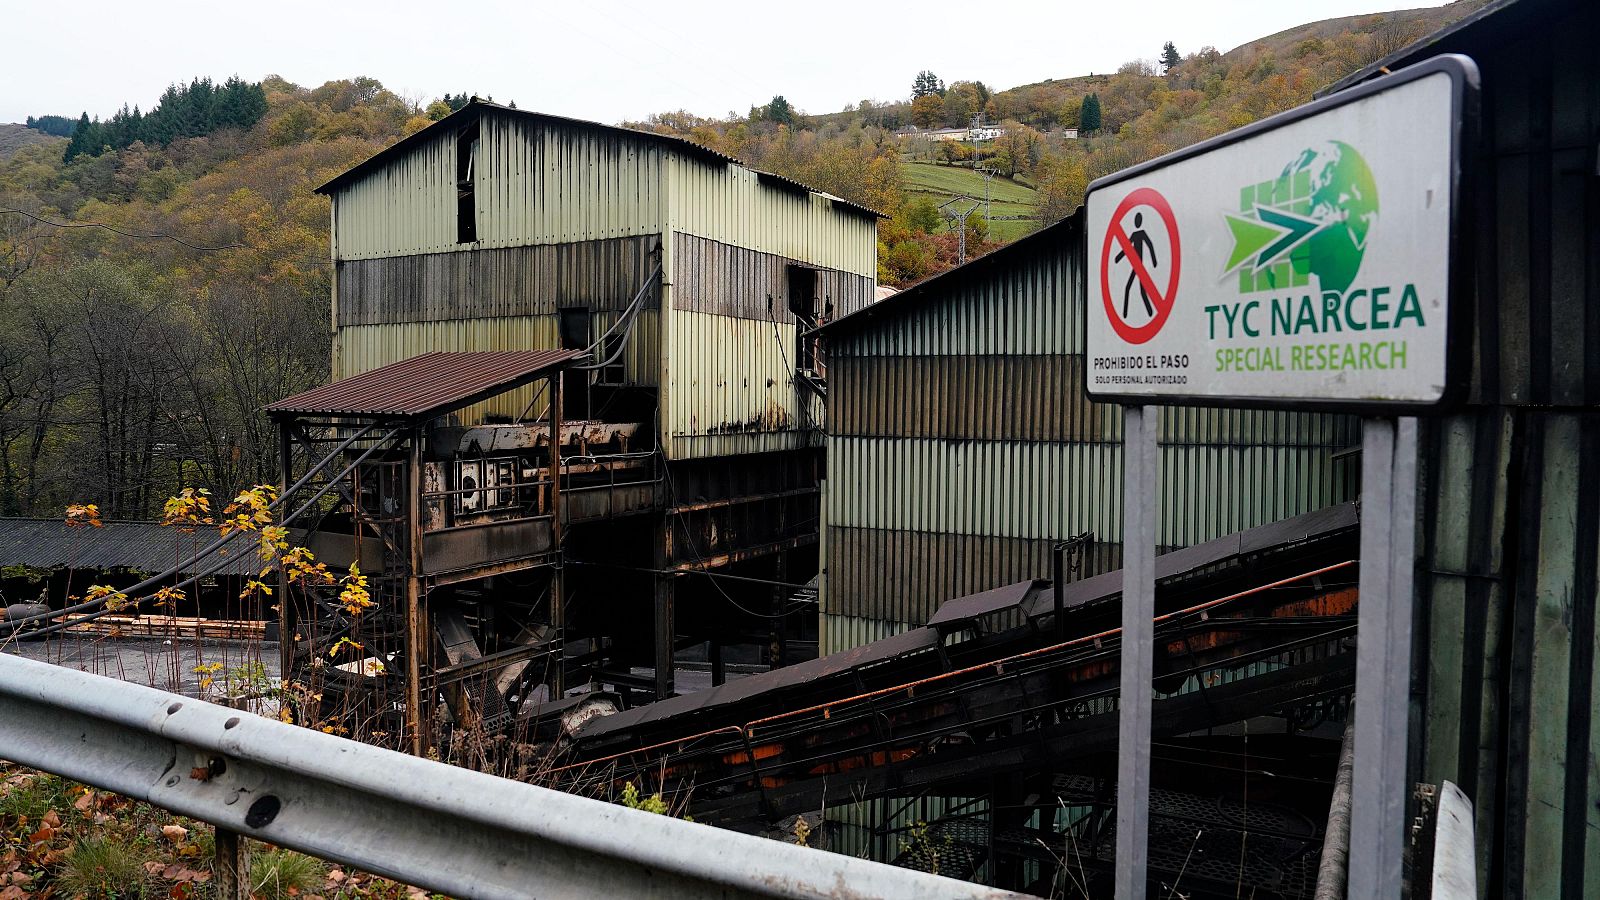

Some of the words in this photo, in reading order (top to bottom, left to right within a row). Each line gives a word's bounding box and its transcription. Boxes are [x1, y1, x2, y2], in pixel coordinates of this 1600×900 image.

[1204, 301, 1259, 340] TYC
[1271, 284, 1426, 336] NARCEA
[1094, 356, 1143, 370] PROHIBIDO
[1146, 355, 1158, 369] EL
[1161, 354, 1189, 368] PASO
[1216, 347, 1284, 372] SPECIAL
[1291, 341, 1407, 370] RESEARCH
[1095, 375, 1110, 384] SOLO
[1111, 375, 1143, 384] PERSONAL
